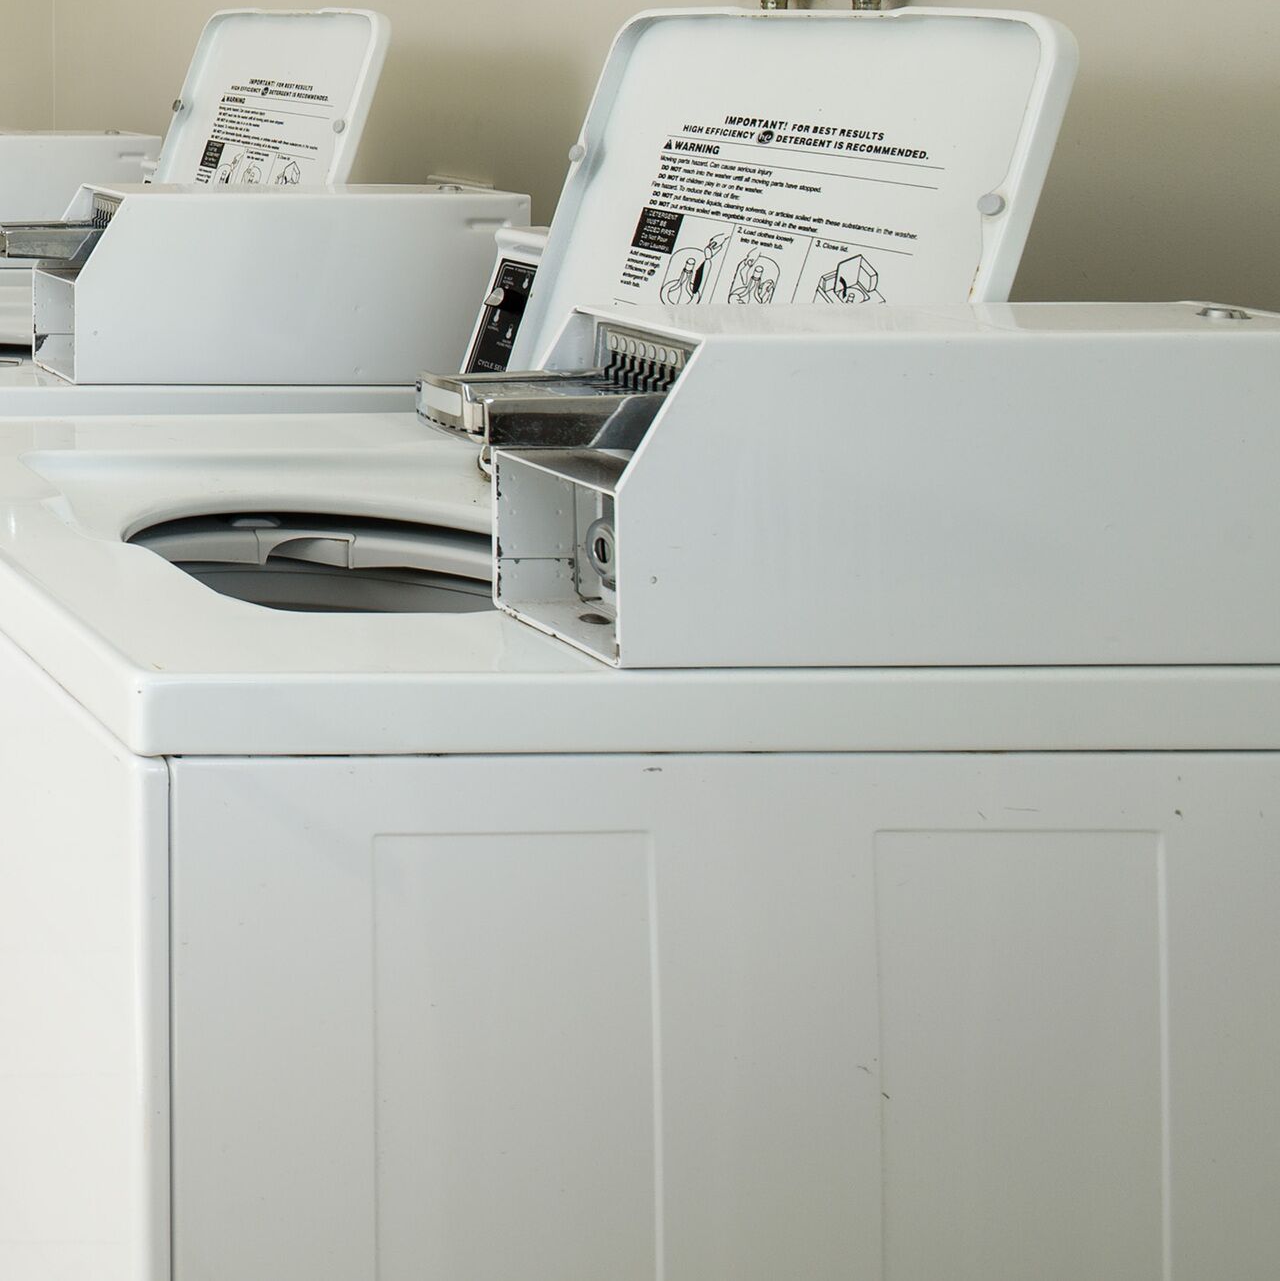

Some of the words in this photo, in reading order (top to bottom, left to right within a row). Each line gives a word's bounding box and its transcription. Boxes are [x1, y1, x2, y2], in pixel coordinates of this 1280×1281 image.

[725, 116, 788, 130] IMPORTANT!
[791, 124, 809, 133] FOR
[812, 126, 837, 136] BEST
[839, 129, 884, 141] RESULTS
[675, 141, 720, 154] WARNING
[683, 125, 703, 133] HIGH
[705, 127, 755, 139] EFFICIENCY
[776, 134, 832, 148] DETERGENT
[846, 143, 928, 159] RECOMMENDED.
[660, 155, 678, 164] Moving
[757, 231, 775, 239] clothes
[776, 235, 794, 243] loosely
[823, 242, 839, 251] Close
[478, 359, 494, 368] CYCLE
